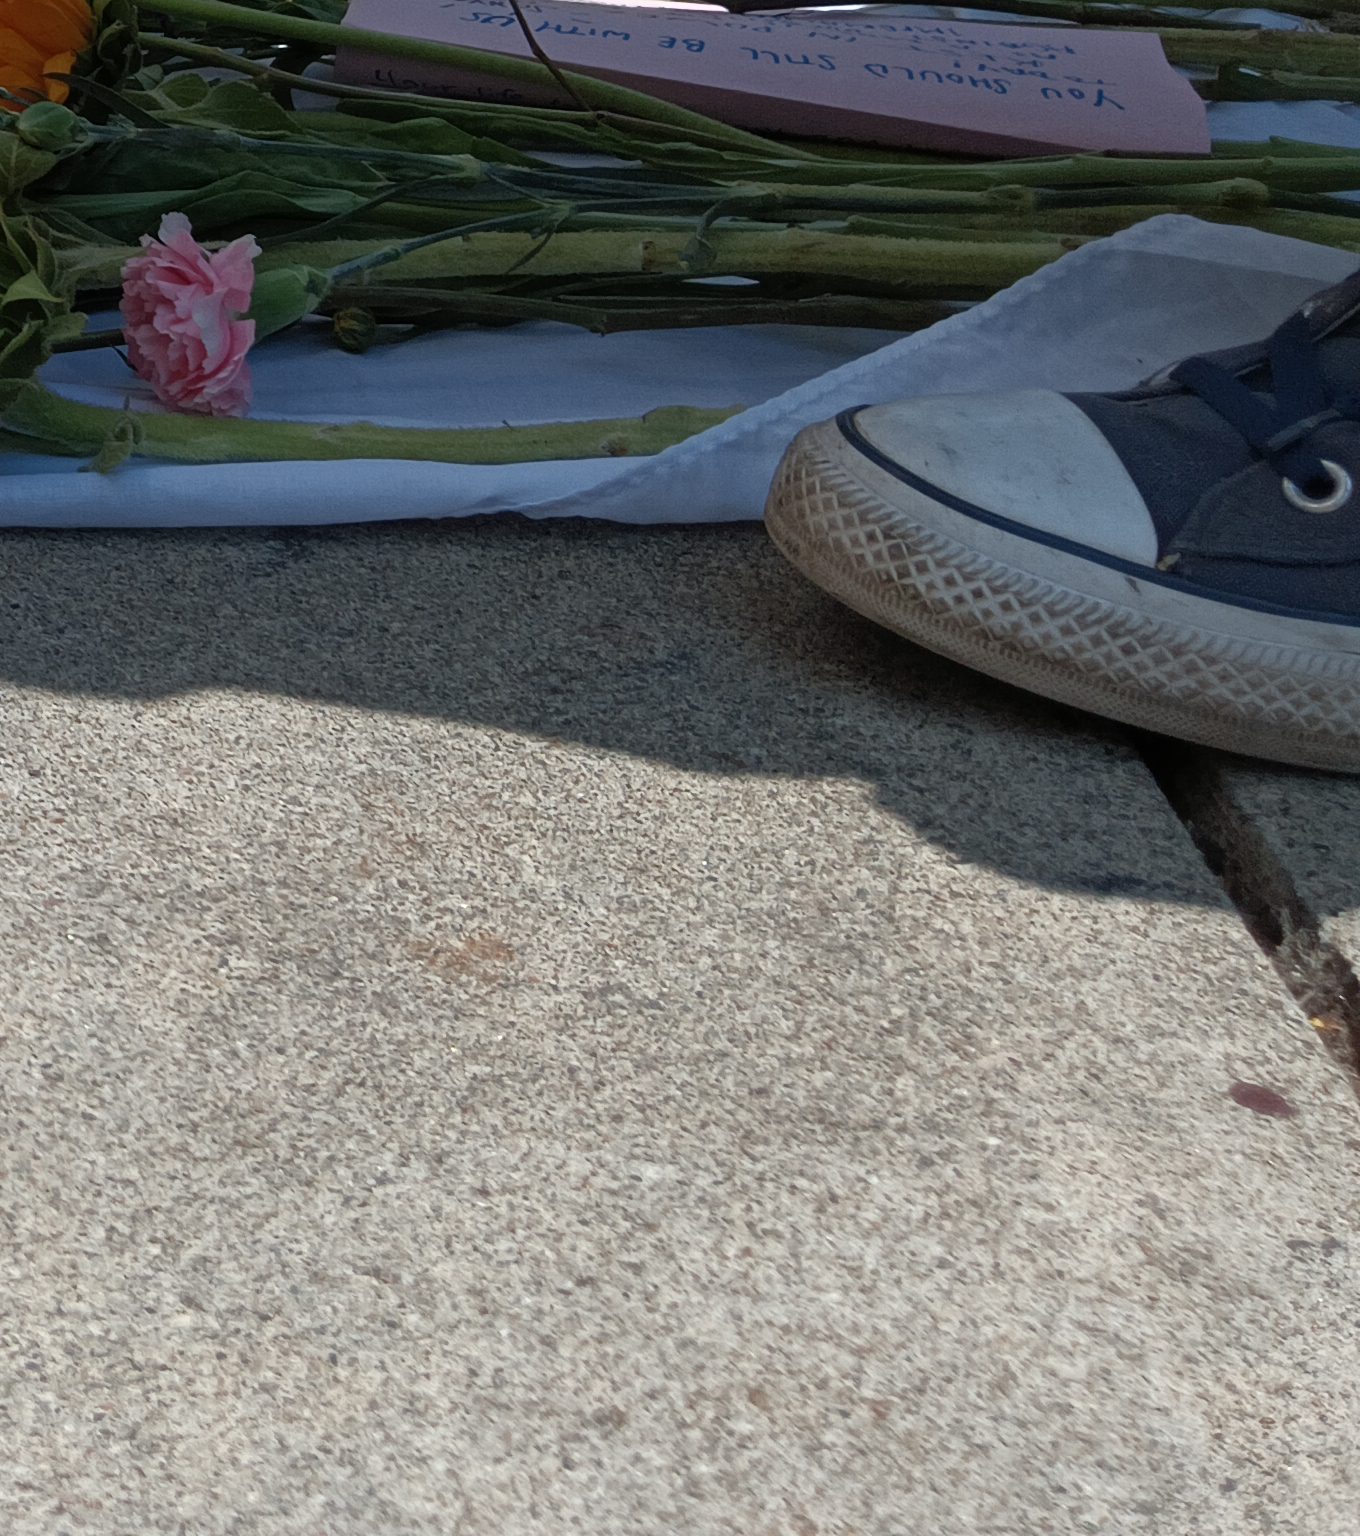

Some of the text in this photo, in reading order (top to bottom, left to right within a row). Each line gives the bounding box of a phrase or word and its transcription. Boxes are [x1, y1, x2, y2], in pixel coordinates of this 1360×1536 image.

[458, 10, 518, 28] US
[533, 19, 632, 42] WITH
[657, 34, 707, 54] BE
[864, 63, 1012, 95] SHOULD
[1040, 86, 1126, 111] YOU
